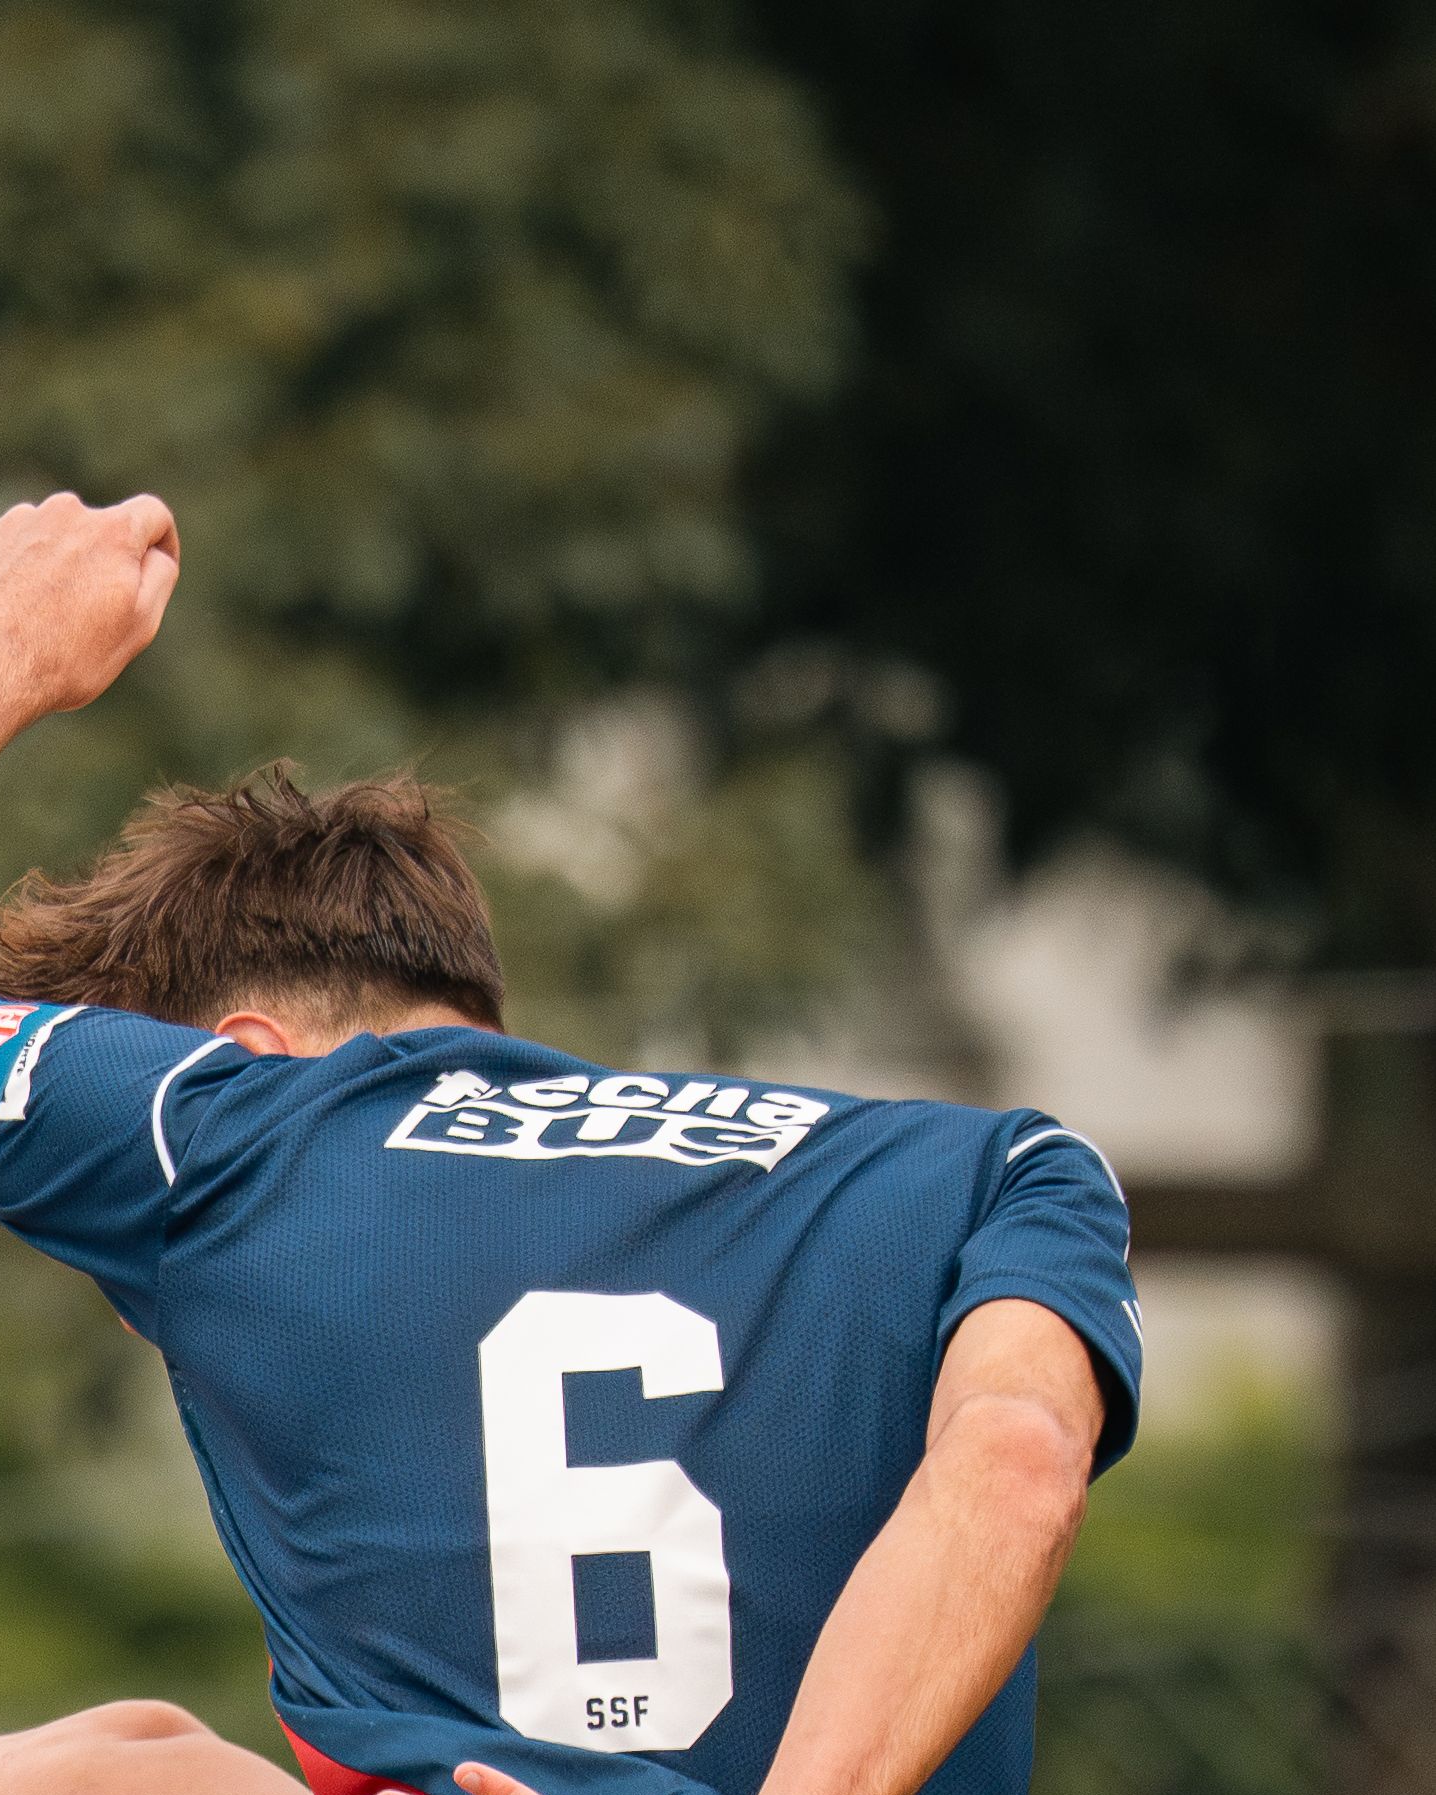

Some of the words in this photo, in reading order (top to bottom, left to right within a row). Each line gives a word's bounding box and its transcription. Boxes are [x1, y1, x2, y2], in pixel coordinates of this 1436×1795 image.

[403, 1106, 786, 1163] BUS
[478, 1290, 734, 1752] 6
[585, 1695, 650, 1732] SSF
